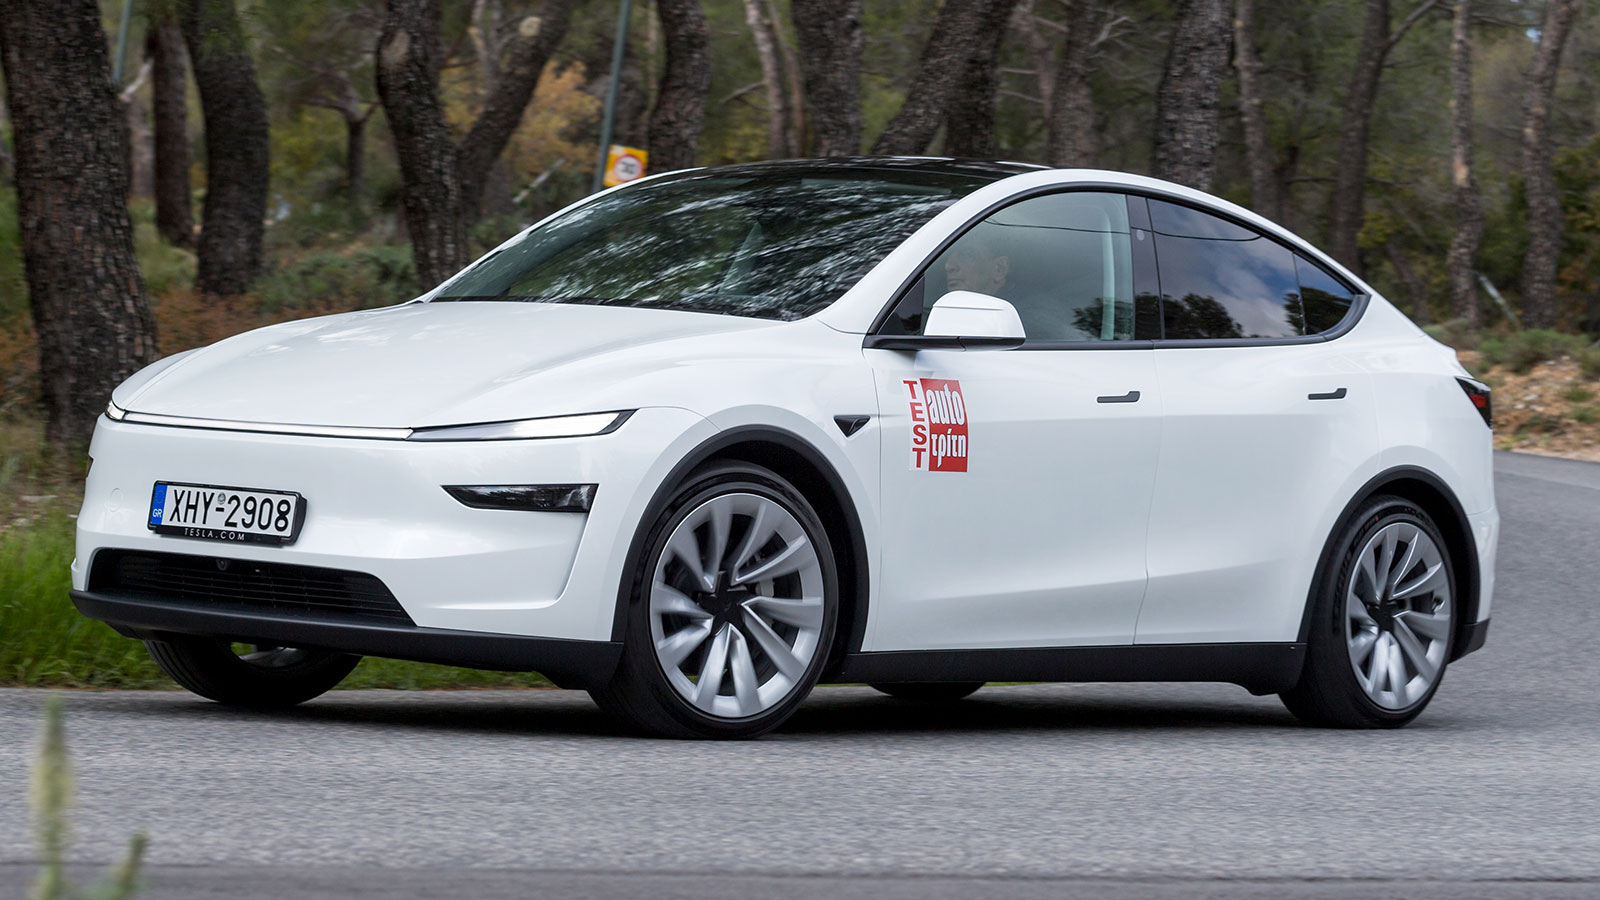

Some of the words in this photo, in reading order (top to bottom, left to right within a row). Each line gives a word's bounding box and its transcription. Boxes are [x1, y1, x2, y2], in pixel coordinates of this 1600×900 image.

[903, 380, 927, 468] TEST
[926, 383, 965, 425] auto
[931, 428, 966, 468] τρίτη
[152, 508, 163, 518] GR
[169, 489, 291, 532] XHY-2908
[184, 528, 245, 541] TESLA.COM
